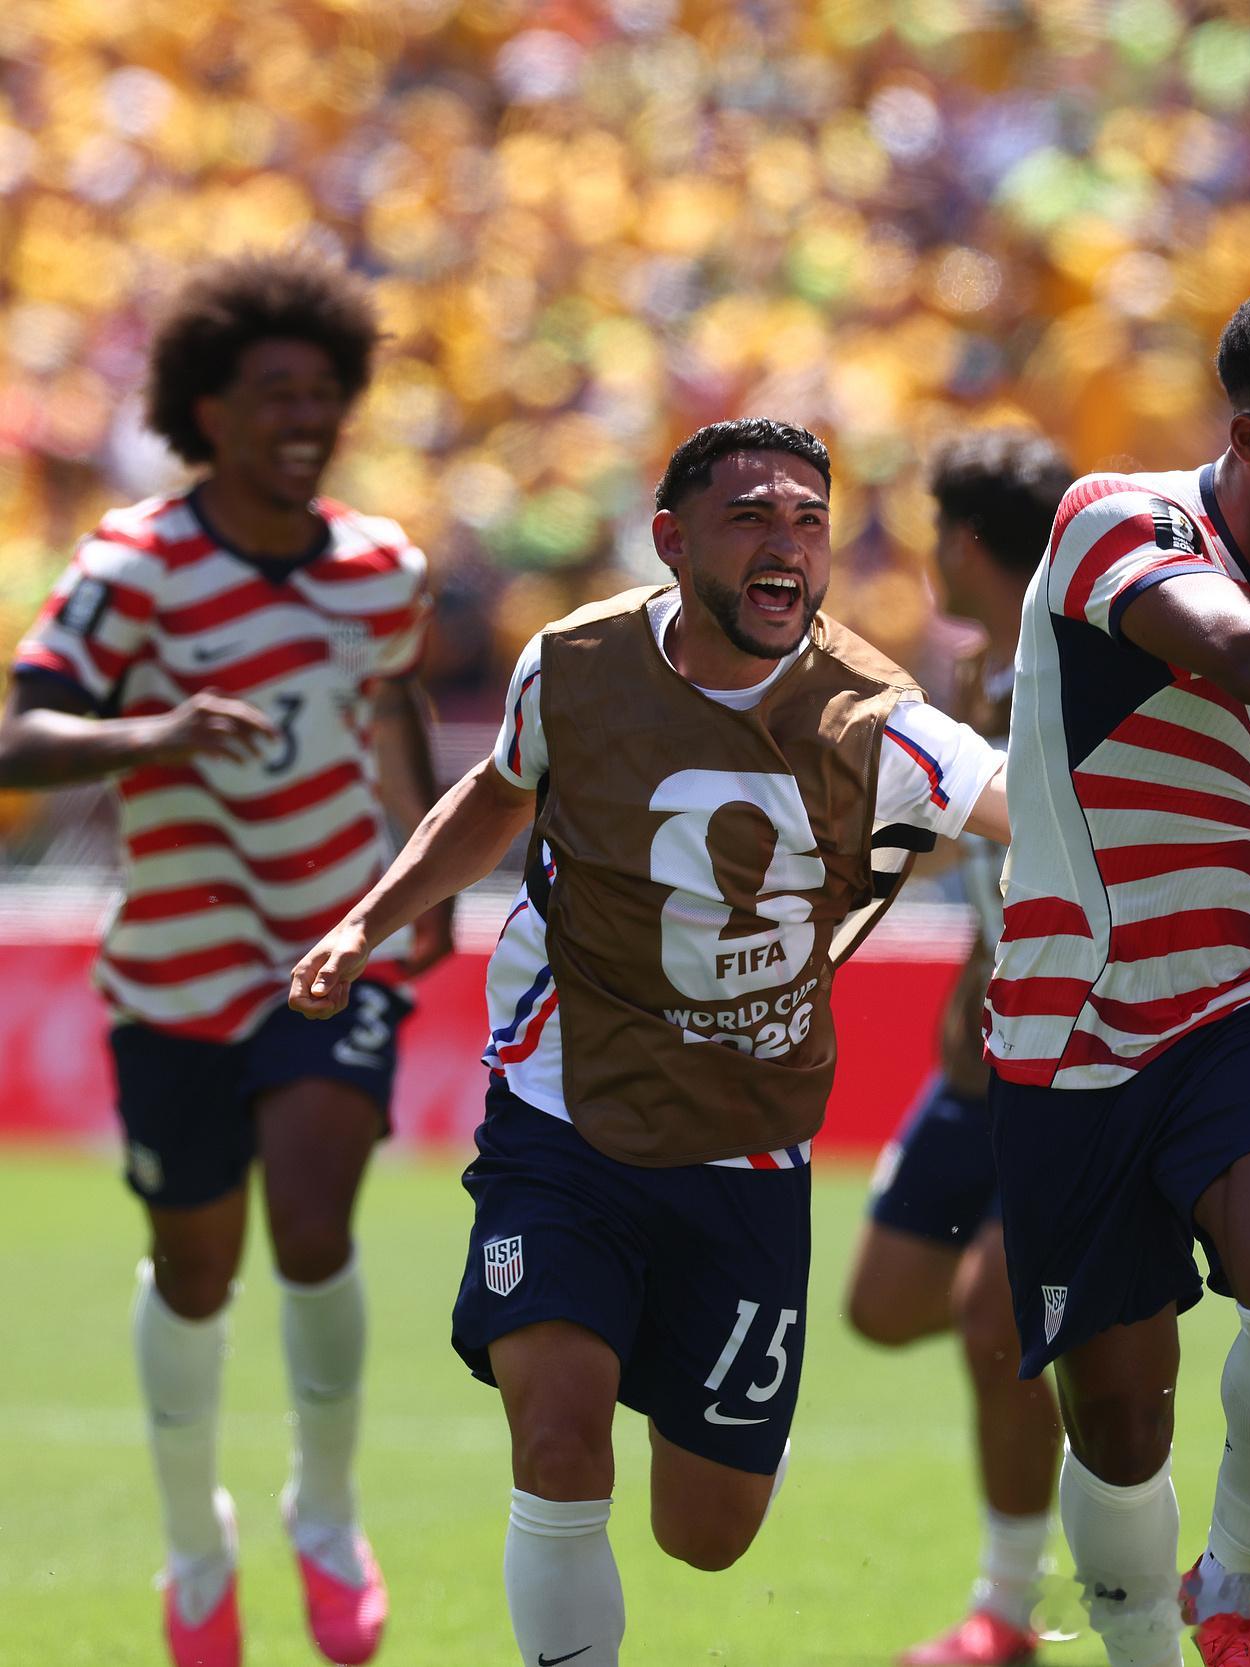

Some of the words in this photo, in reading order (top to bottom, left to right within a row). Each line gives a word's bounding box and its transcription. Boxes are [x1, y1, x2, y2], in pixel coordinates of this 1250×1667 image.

[265, 697, 303, 775] 3
[716, 940, 786, 979] FIFA
[353, 985, 391, 1050] 3
[664, 1001, 769, 1030] WORLD
[683, 1002, 814, 1060] 026
[487, 1239, 519, 1264] USA
[1044, 1289, 1066, 1310] USA
[704, 1299, 798, 1402] 15
